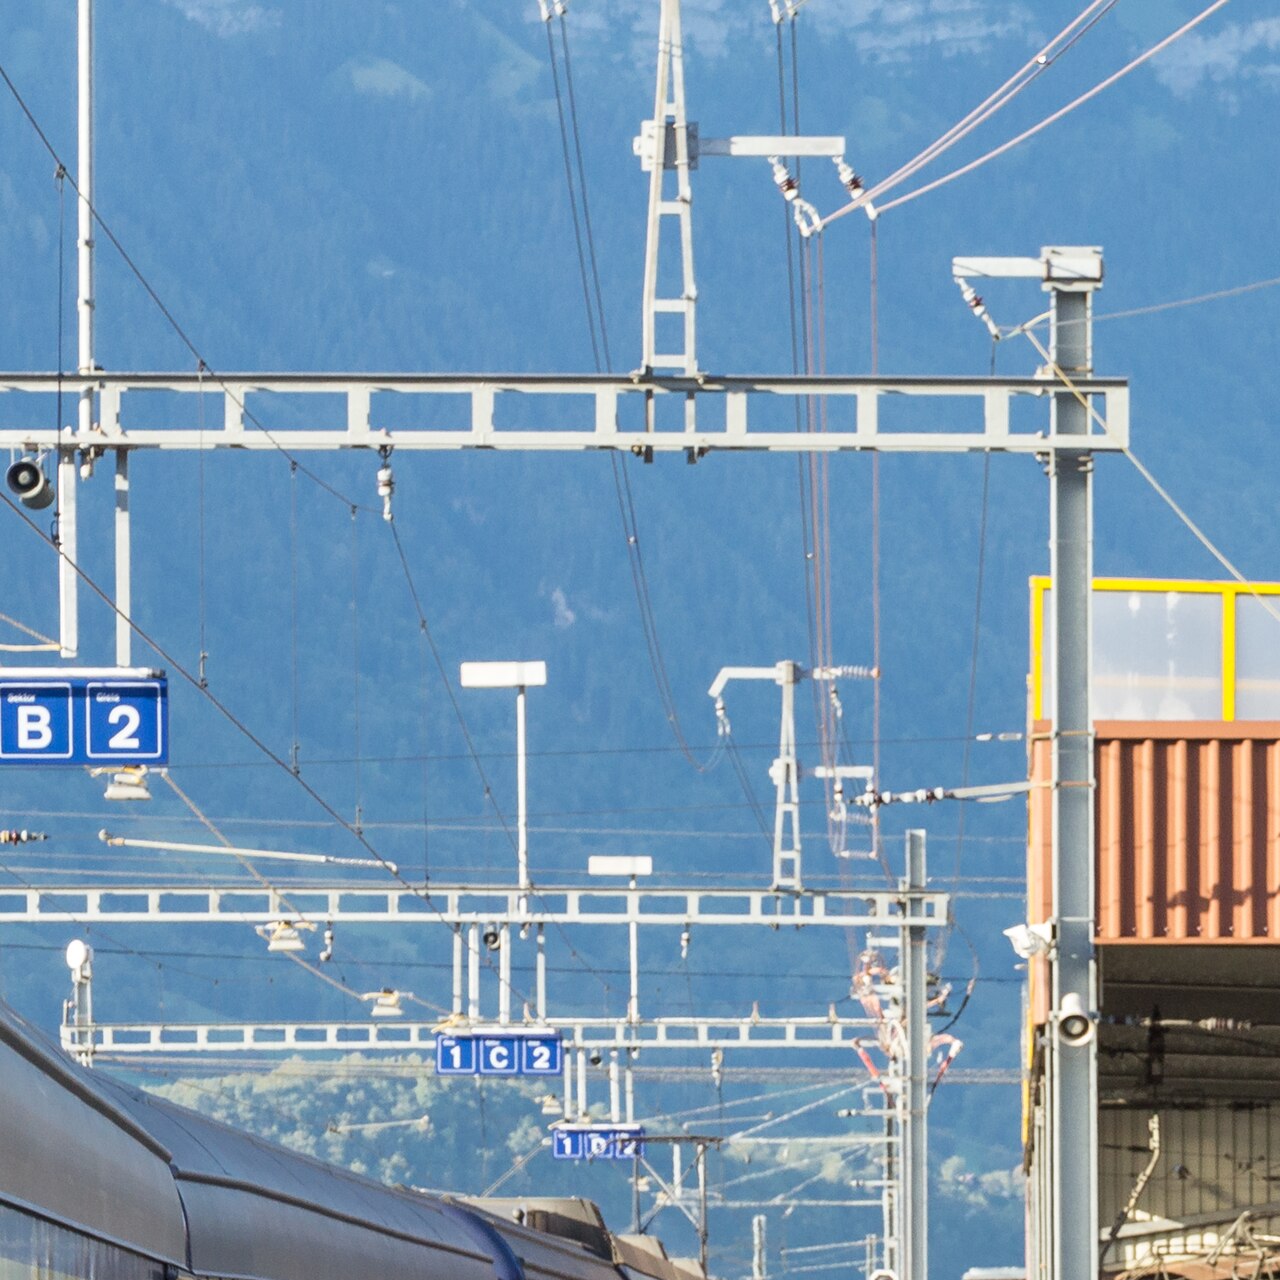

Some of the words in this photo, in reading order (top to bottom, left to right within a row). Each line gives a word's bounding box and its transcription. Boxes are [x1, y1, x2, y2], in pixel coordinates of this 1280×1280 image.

[17, 705, 53, 749] B
[107, 704, 141, 749] 2
[450, 1045, 461, 1069] 1
[489, 1046, 509, 1069] C
[532, 1046, 551, 1069] 2
[562, 1136, 572, 1155] 1
